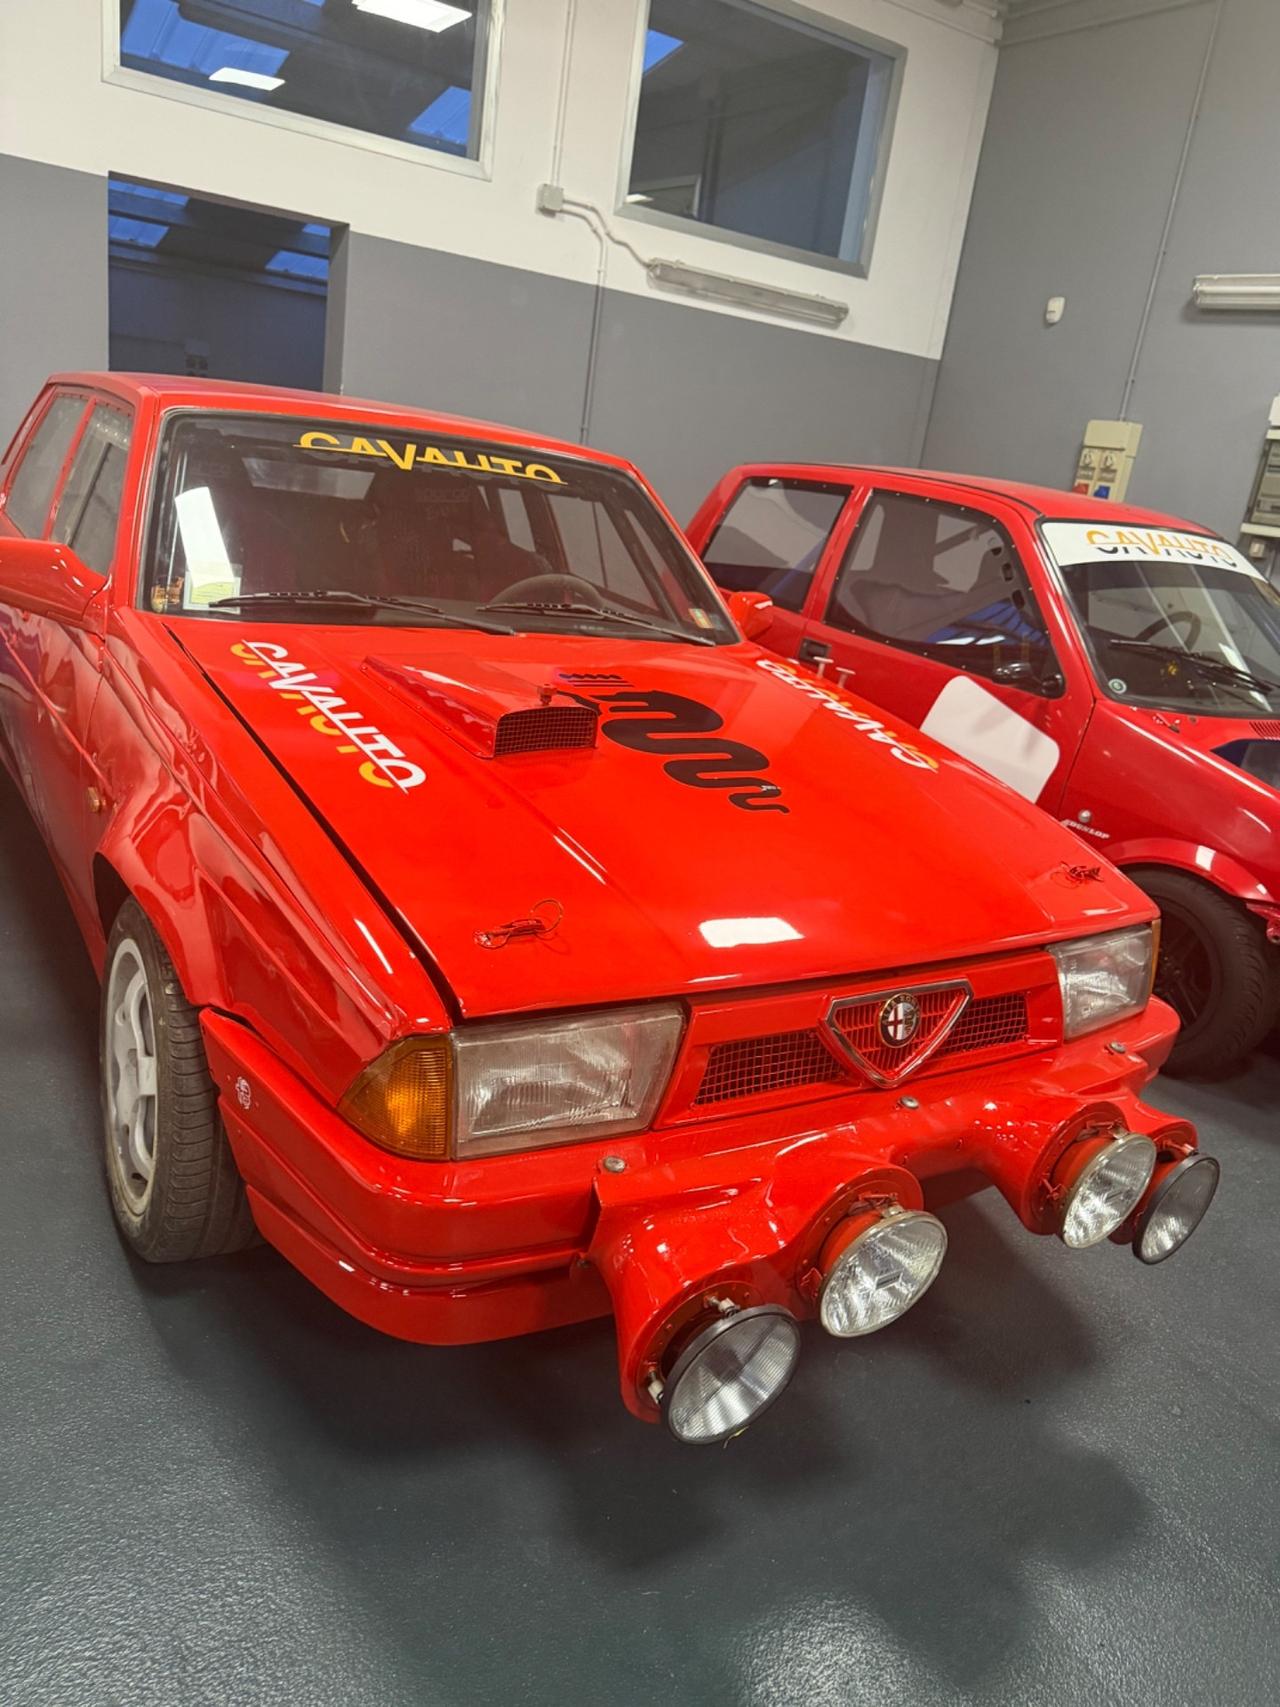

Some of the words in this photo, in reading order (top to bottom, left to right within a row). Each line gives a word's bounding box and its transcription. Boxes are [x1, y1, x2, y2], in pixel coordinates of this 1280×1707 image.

[293, 431, 568, 488] CAVAUTO
[1085, 529, 1238, 568] CAVAUTO
[230, 639, 426, 794] CAVAUTO
[755, 659, 939, 773] CAVAUTO
